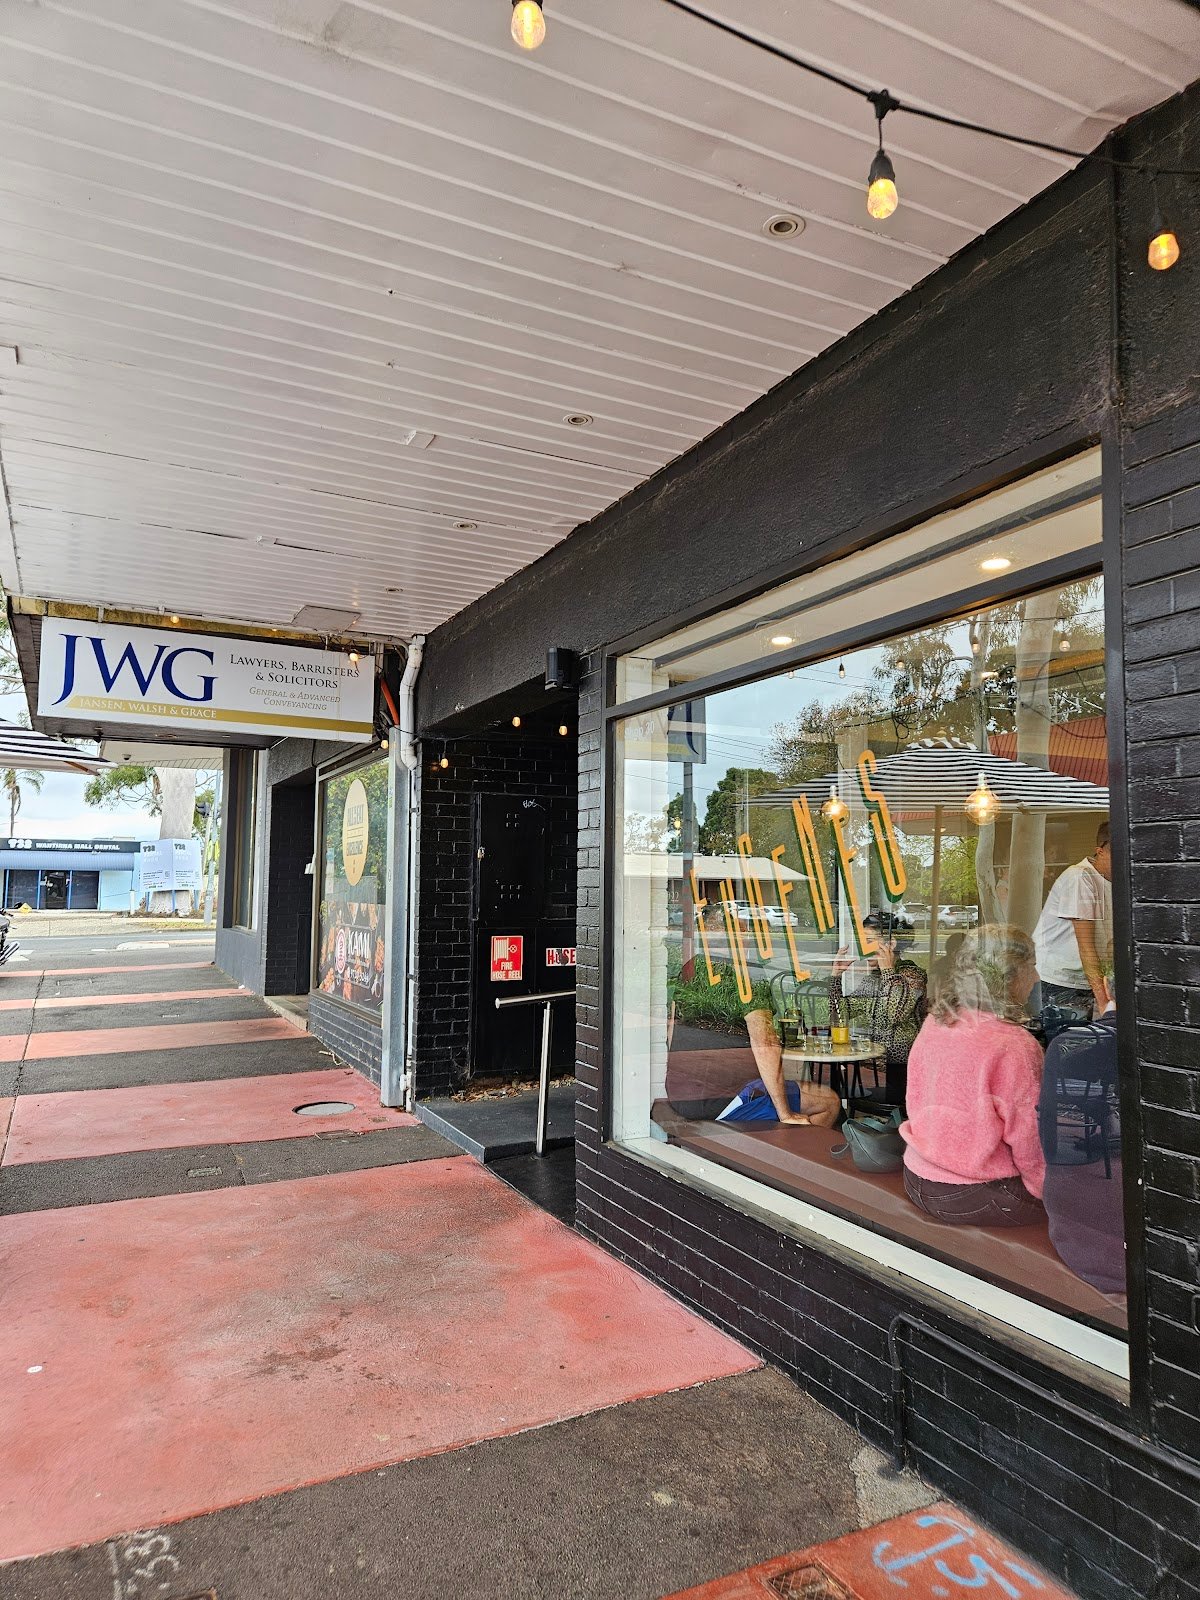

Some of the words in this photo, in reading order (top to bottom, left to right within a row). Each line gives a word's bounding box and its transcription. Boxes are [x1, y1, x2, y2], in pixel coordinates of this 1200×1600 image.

[51, 634, 218, 706] JWG
[255, 672, 264, 681] &
[289, 691, 296, 699] &
[80, 698, 125, 711] JANSEN,
[128, 702, 167, 714] WALSH
[170, 706, 178, 715] &
[180, 707, 217, 719] GRACE
[689, 749, 908, 1004] EUGENES
[500, 961, 513, 971] FIRE
